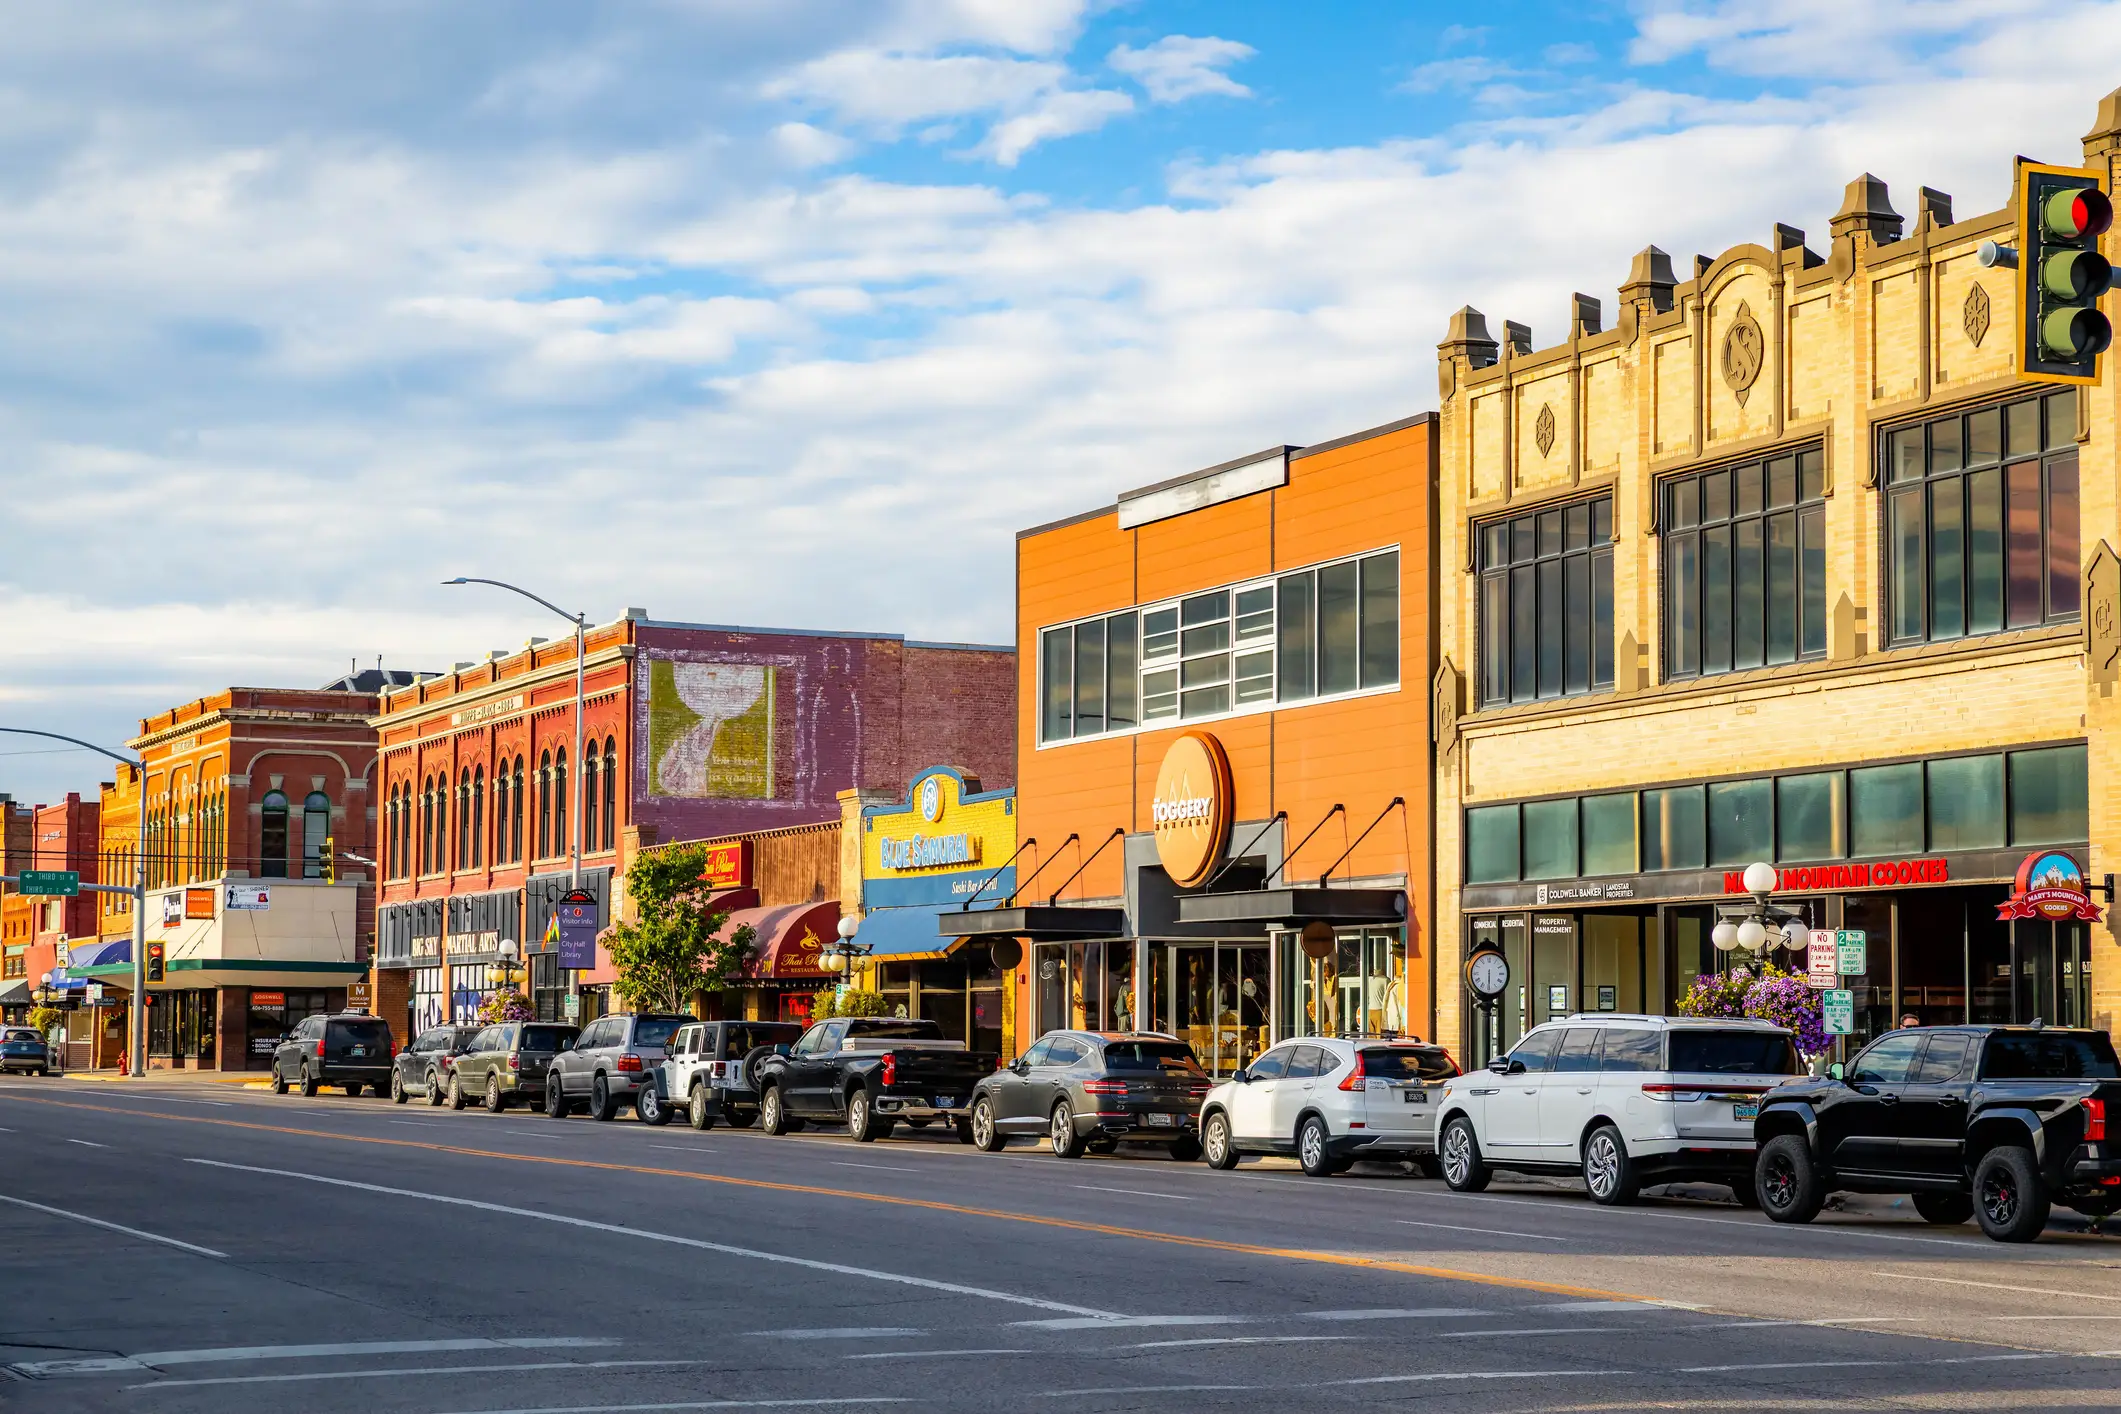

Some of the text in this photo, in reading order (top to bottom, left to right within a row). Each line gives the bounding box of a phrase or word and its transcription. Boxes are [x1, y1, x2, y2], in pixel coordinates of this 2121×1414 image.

[1152, 797, 1212, 822] TOGGERY
[1155, 818, 1209, 831] MONTANA
[912, 833, 969, 867] SAMURAI
[38, 872, 56, 881] THIRD
[1783, 864, 1869, 891] MOUNTAIN
[1872, 858, 1948, 886] COOKIES
[26, 885, 43, 894] THIRD
[952, 881, 967, 894] Sushi
[967, 880, 978, 893] Bar
[1606, 883, 1630, 891] LANDSTAR
[565, 890, 591, 899] HISTORIC
[1549, 888, 1602, 899] COLDWELL BANKER
[1606, 890, 1634, 899] PROPERTIES
[2027, 891, 2085, 904] MARY'S MOUNTAIN
[1473, 920, 1497, 929] COMMERCIAL
[1501, 919, 1524, 928] RESIDENTIAL
[1817, 934, 1828, 943] NO
[1838, 933, 1845, 945] 2
[412, 931, 498, 957] BIG SKY MARTIAL ARTS
[1810, 944, 1834, 953] PARKING
[561, 951, 581, 959] Library
[781, 954, 803, 967] Thai
[355, 986, 364, 995] M
[1825, 995, 1833, 1003] 30
